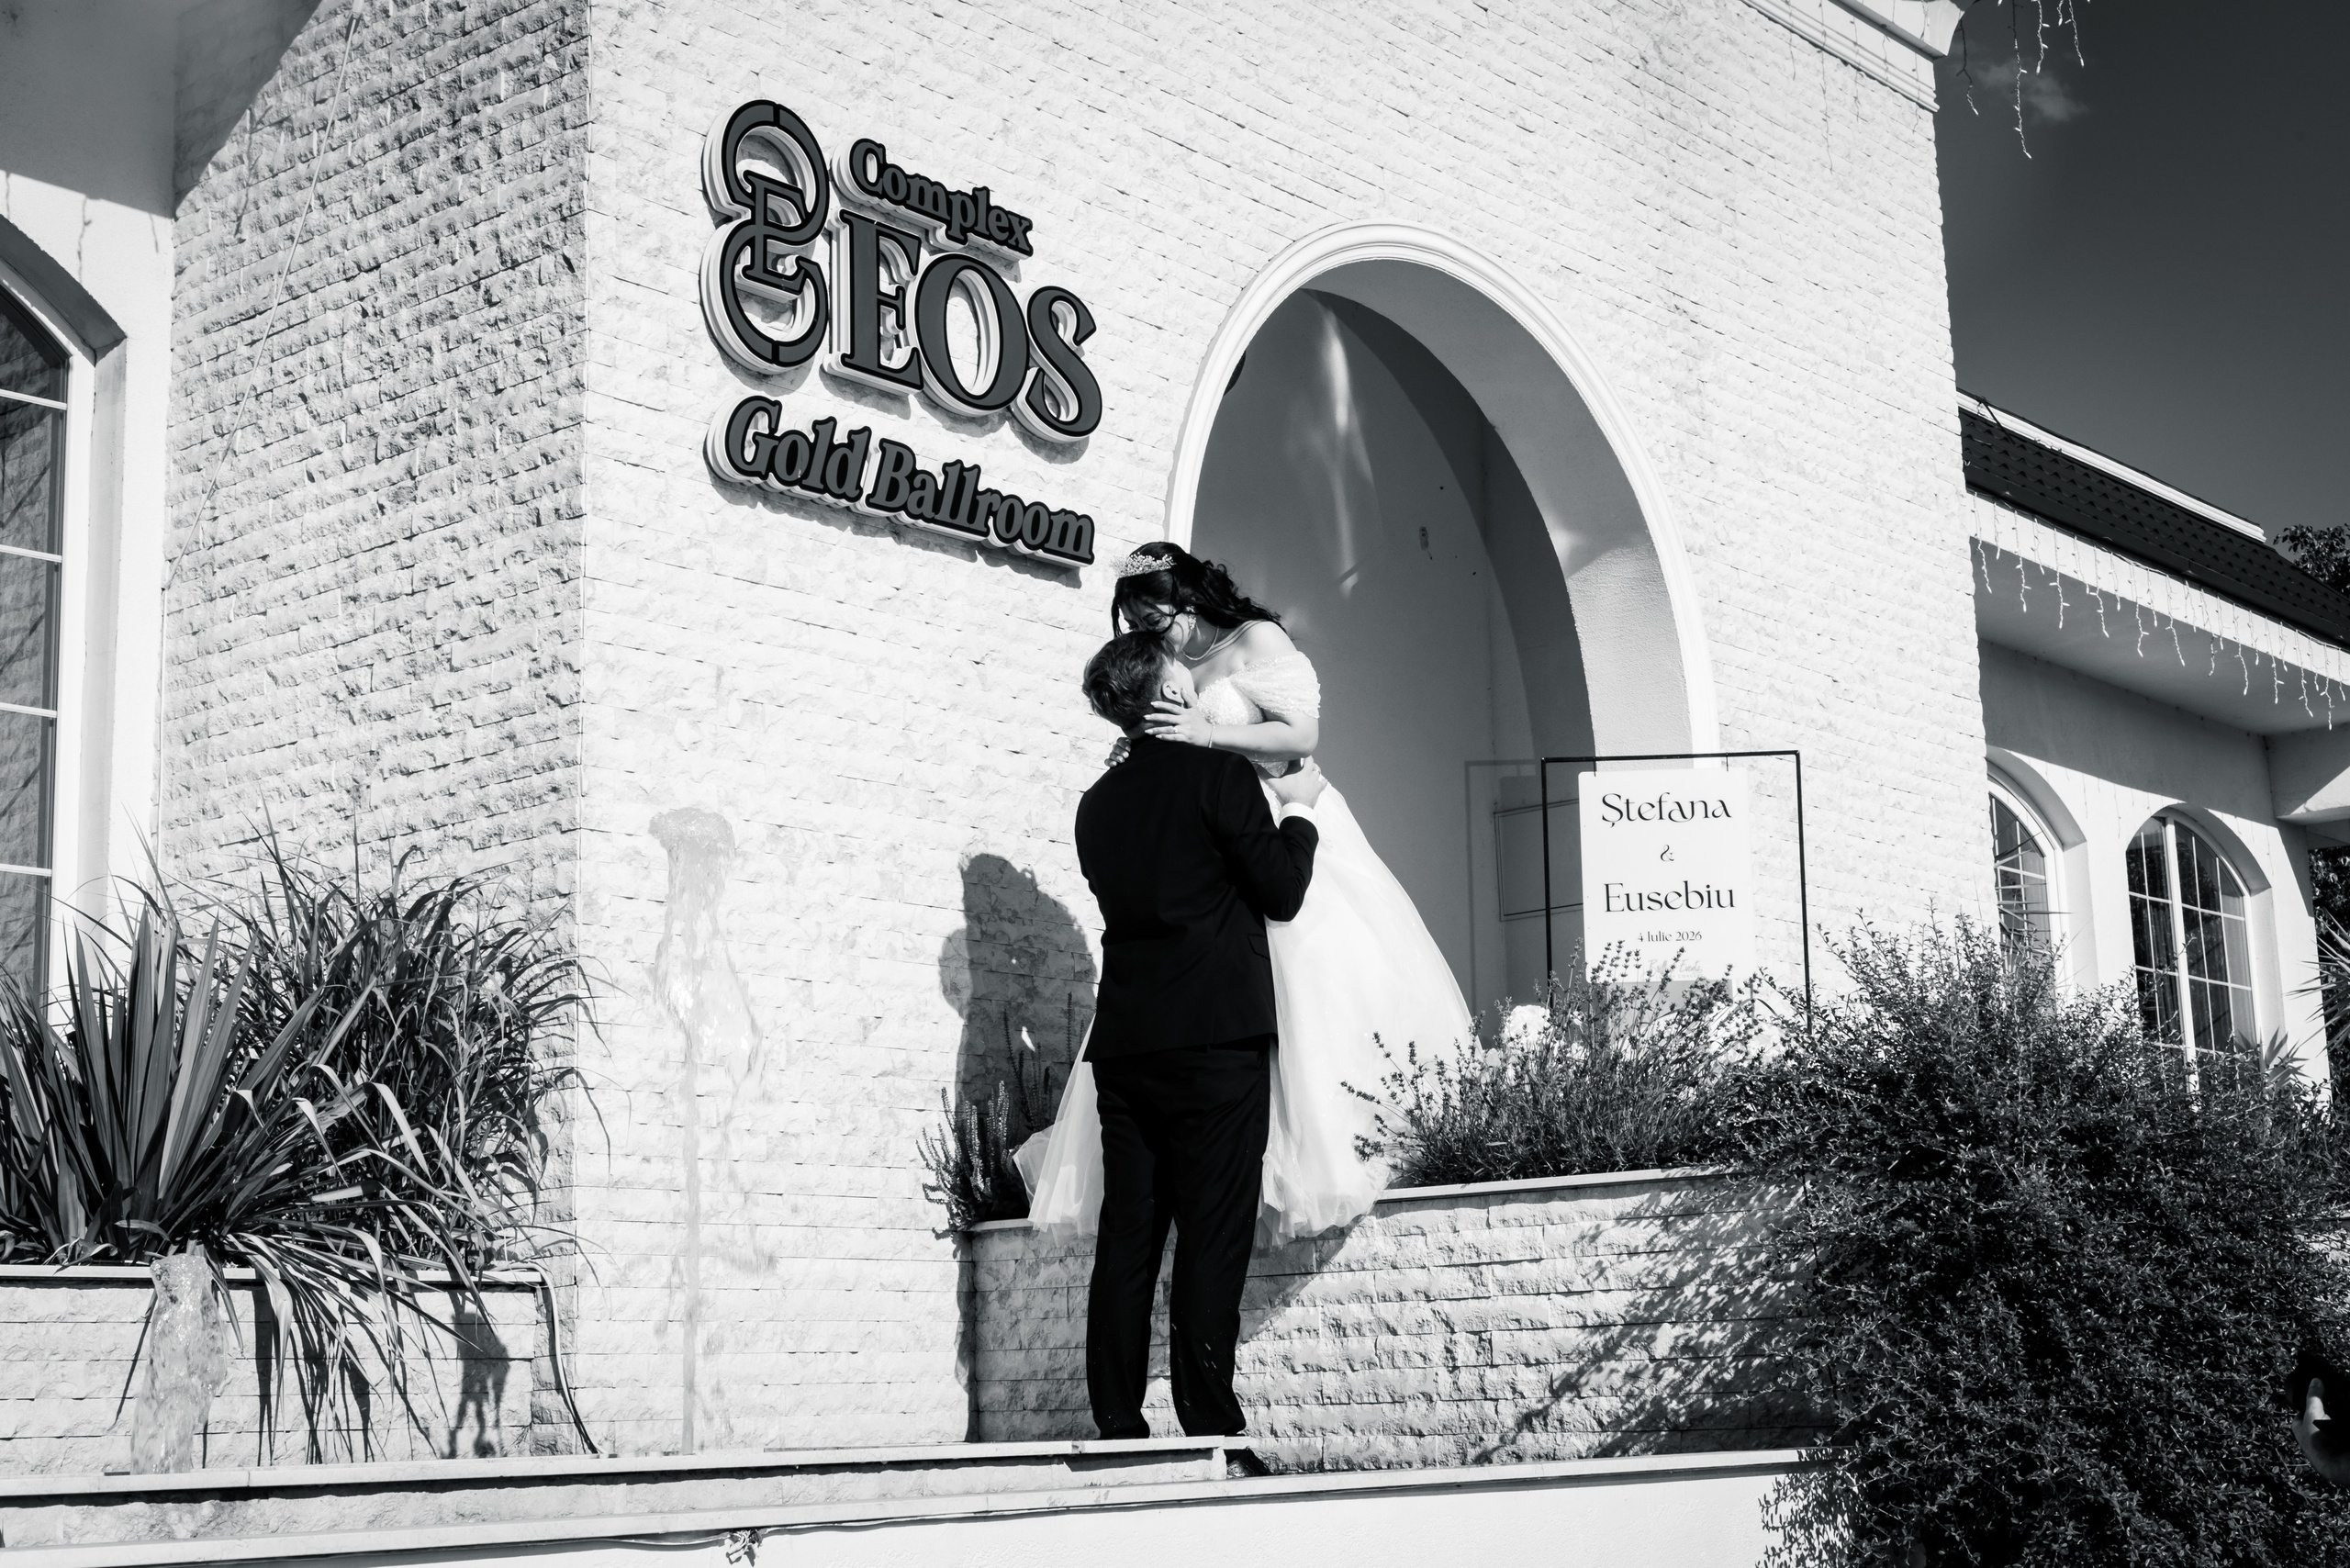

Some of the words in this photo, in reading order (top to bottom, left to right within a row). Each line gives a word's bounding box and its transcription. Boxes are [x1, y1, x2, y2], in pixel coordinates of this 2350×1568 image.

[849, 138, 1034, 257] Complex
[839, 208, 1102, 438] EOS
[724, 395, 873, 504] Gold
[868, 438, 1095, 566] Ballroom
[1601, 791, 1732, 828] Ștefana
[1660, 844, 1674, 862] &
[1604, 879, 1736, 913] Eusebiu
[1638, 932, 1644, 942] 4
[1647, 930, 1673, 942] Iulie
[1675, 930, 1703, 942] 2026
